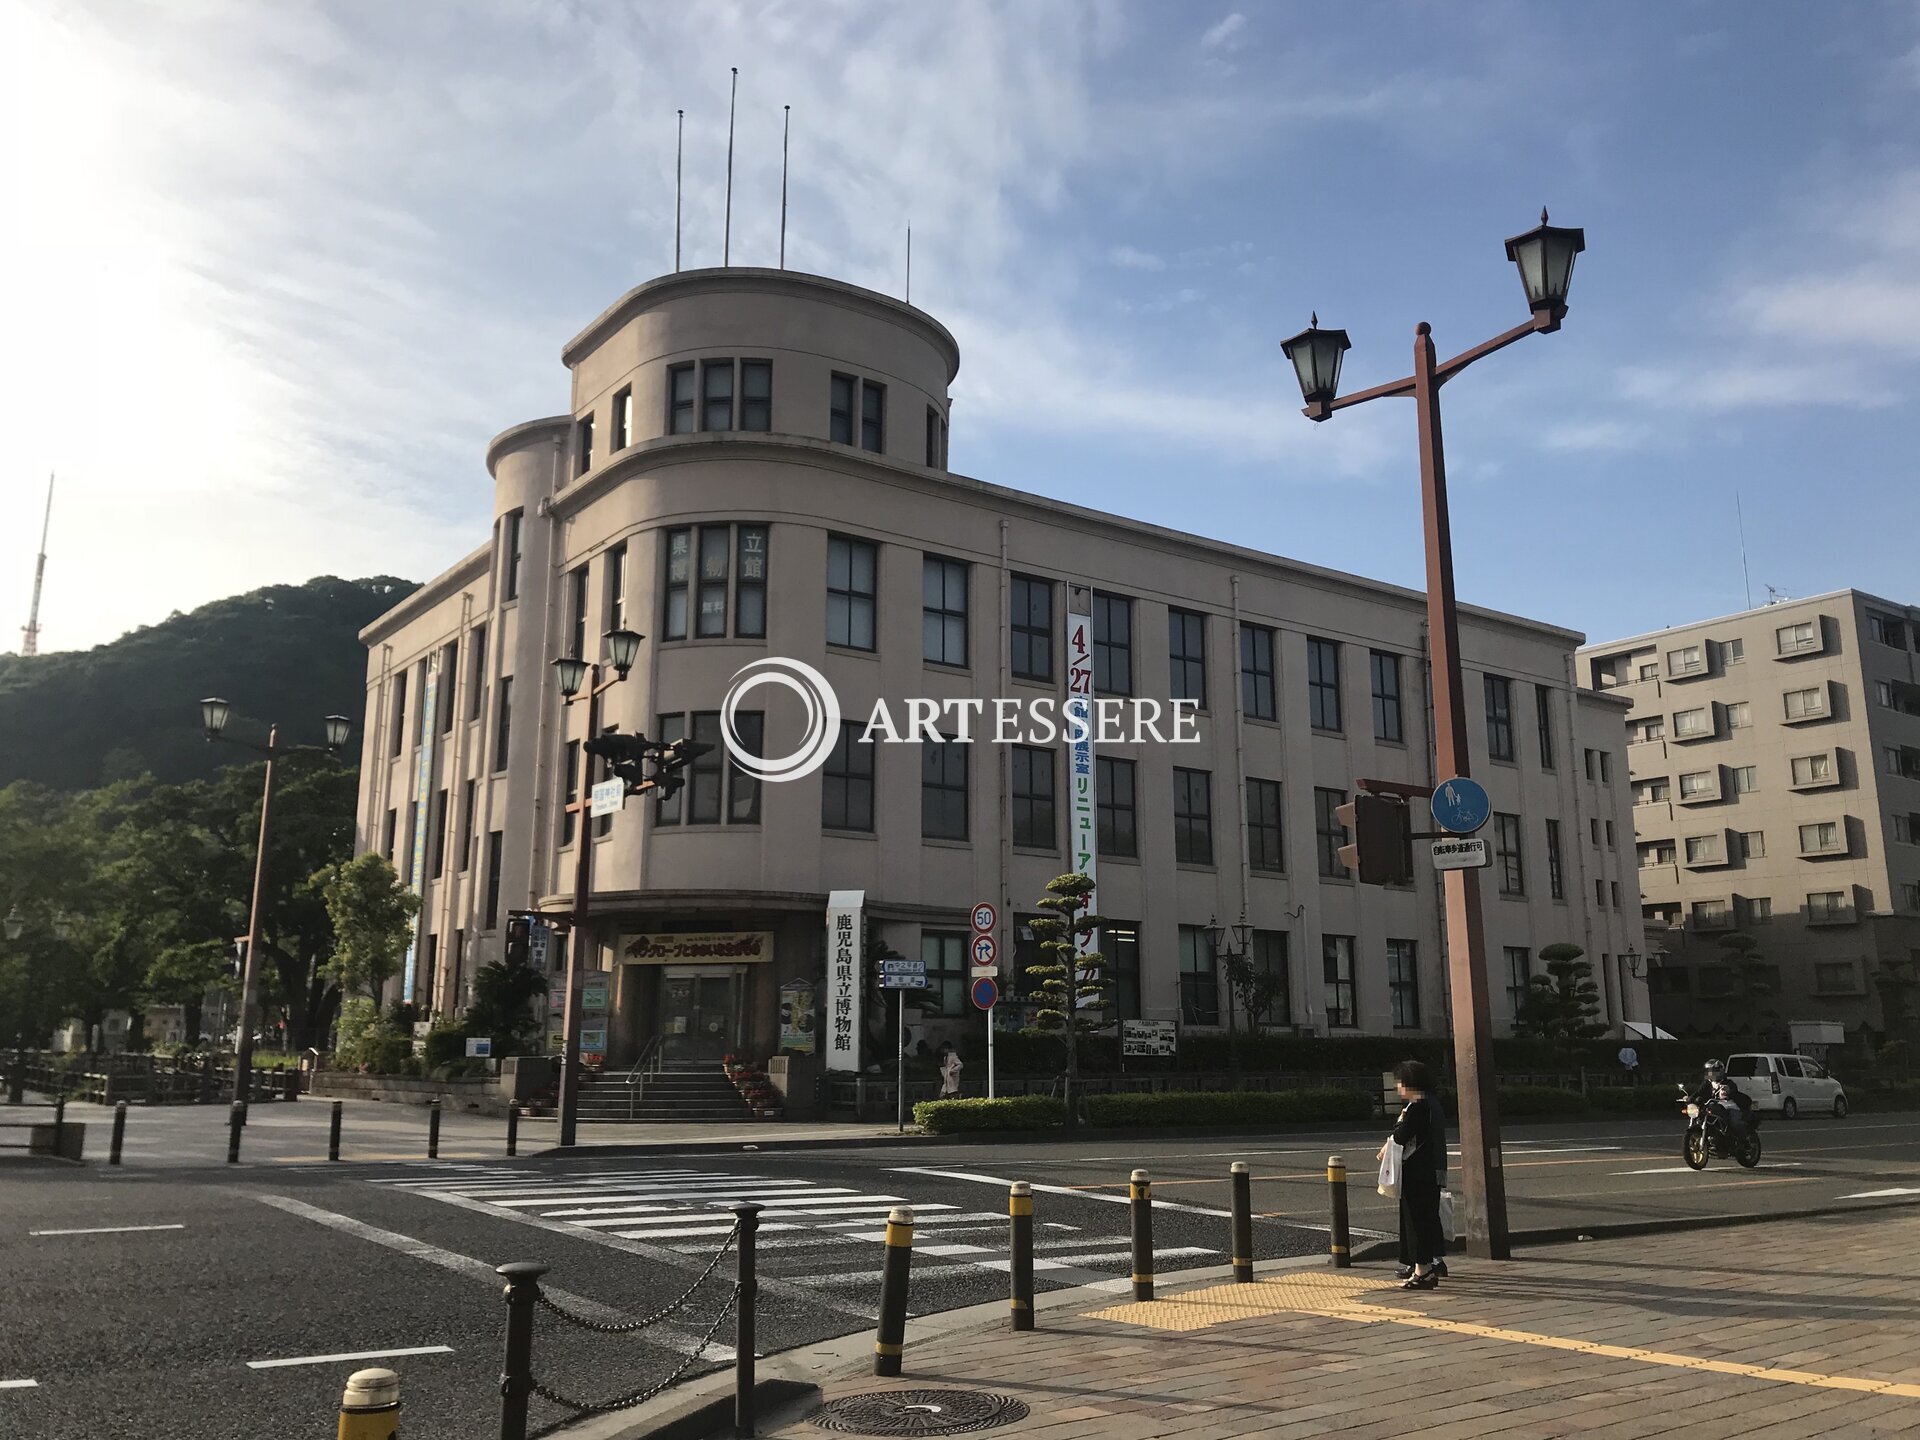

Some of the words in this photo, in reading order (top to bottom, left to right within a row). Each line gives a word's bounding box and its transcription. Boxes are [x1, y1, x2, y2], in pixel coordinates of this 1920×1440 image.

[977, 912, 991, 925] 50
[834, 913, 853, 1051] 鹿児島県立博物館
